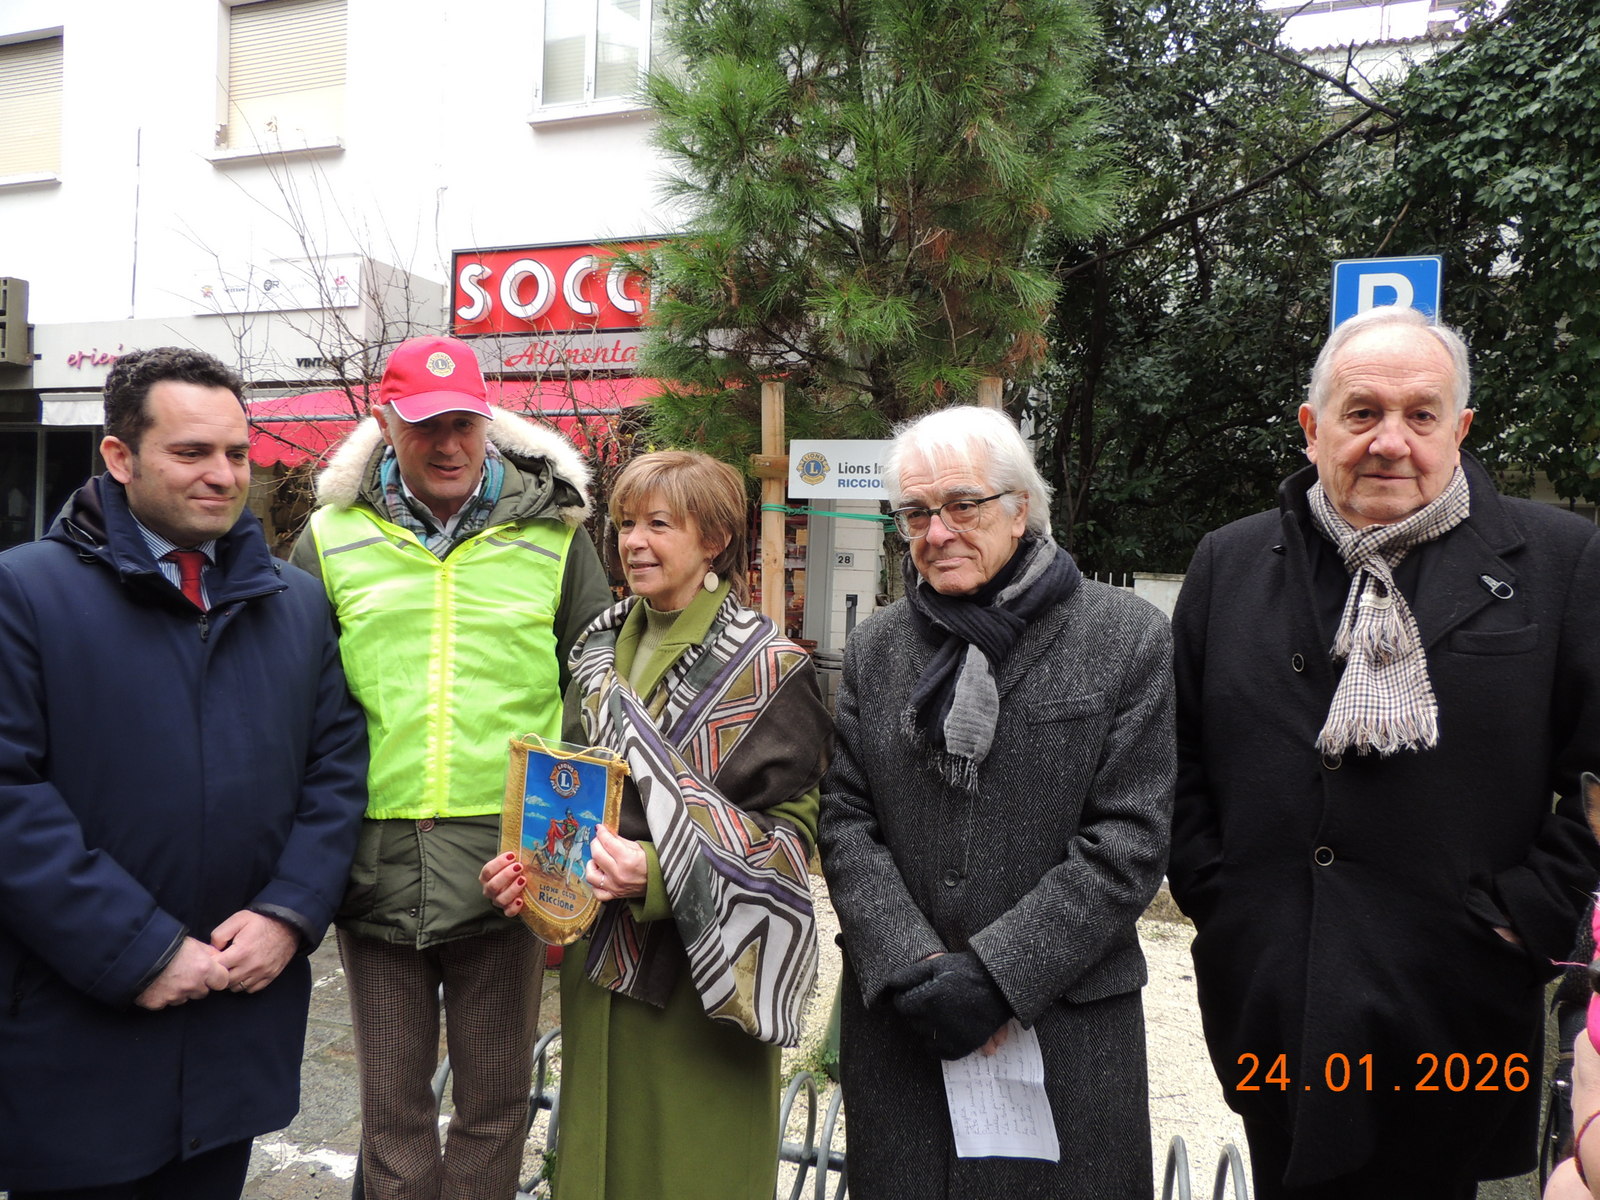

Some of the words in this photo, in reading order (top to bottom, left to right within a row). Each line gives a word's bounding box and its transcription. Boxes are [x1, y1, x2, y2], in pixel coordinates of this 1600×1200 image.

[456, 254, 660, 322] SOCC
[1357, 272, 1414, 315] P
[504, 339, 641, 367] Alimenta
[809, 462, 818, 474] L
[838, 462, 871, 474] Lions
[838, 555, 851, 564] 28
[560, 772, 570, 788] L
[539, 884, 559, 894] LIONS
[561, 890, 577, 901] CLUB
[538, 891, 575, 912] Riccione
